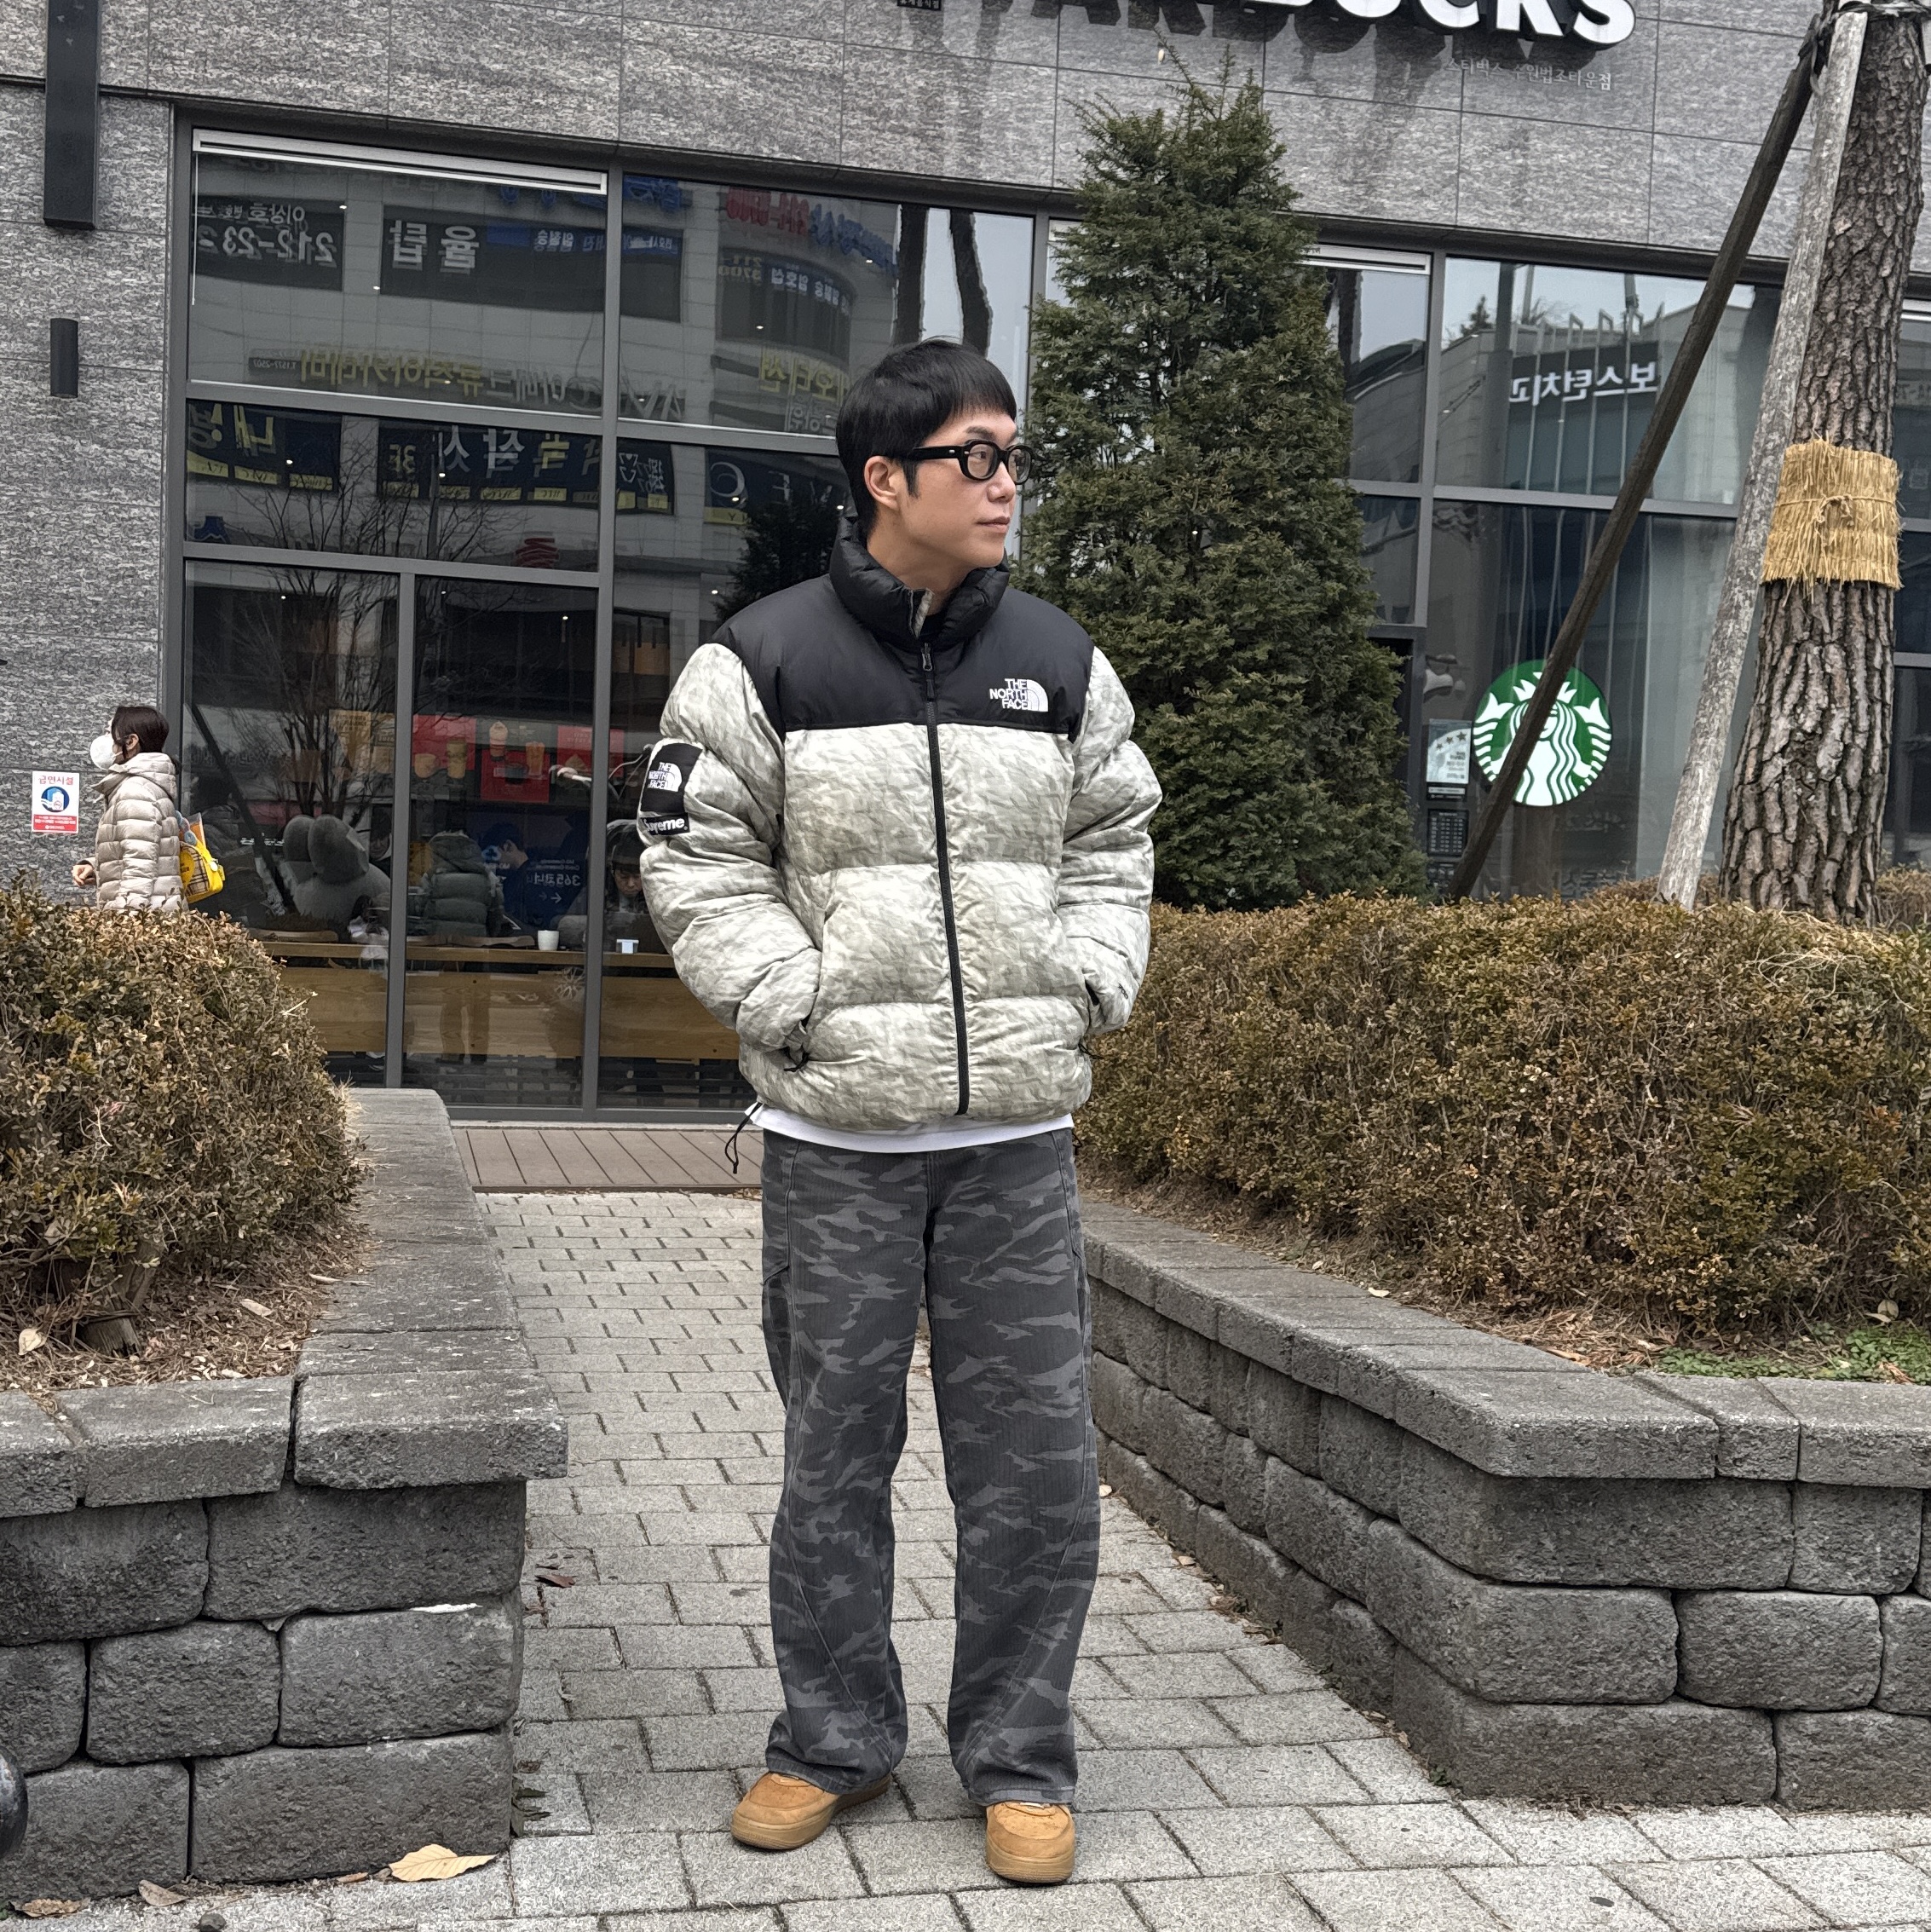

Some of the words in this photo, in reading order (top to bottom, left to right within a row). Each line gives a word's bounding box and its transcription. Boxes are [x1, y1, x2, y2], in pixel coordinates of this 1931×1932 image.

[1446, 57, 1506, 78] 스타벅스
[1511, 63, 1611, 91] 수원법조타운점
[1005, 678, 1028, 689] THE
[989, 688, 1028, 700] NORTH
[1002, 699, 1029, 710] FACE
[657, 761, 671, 771] THE
[38, 775, 74, 786] 금연시설
